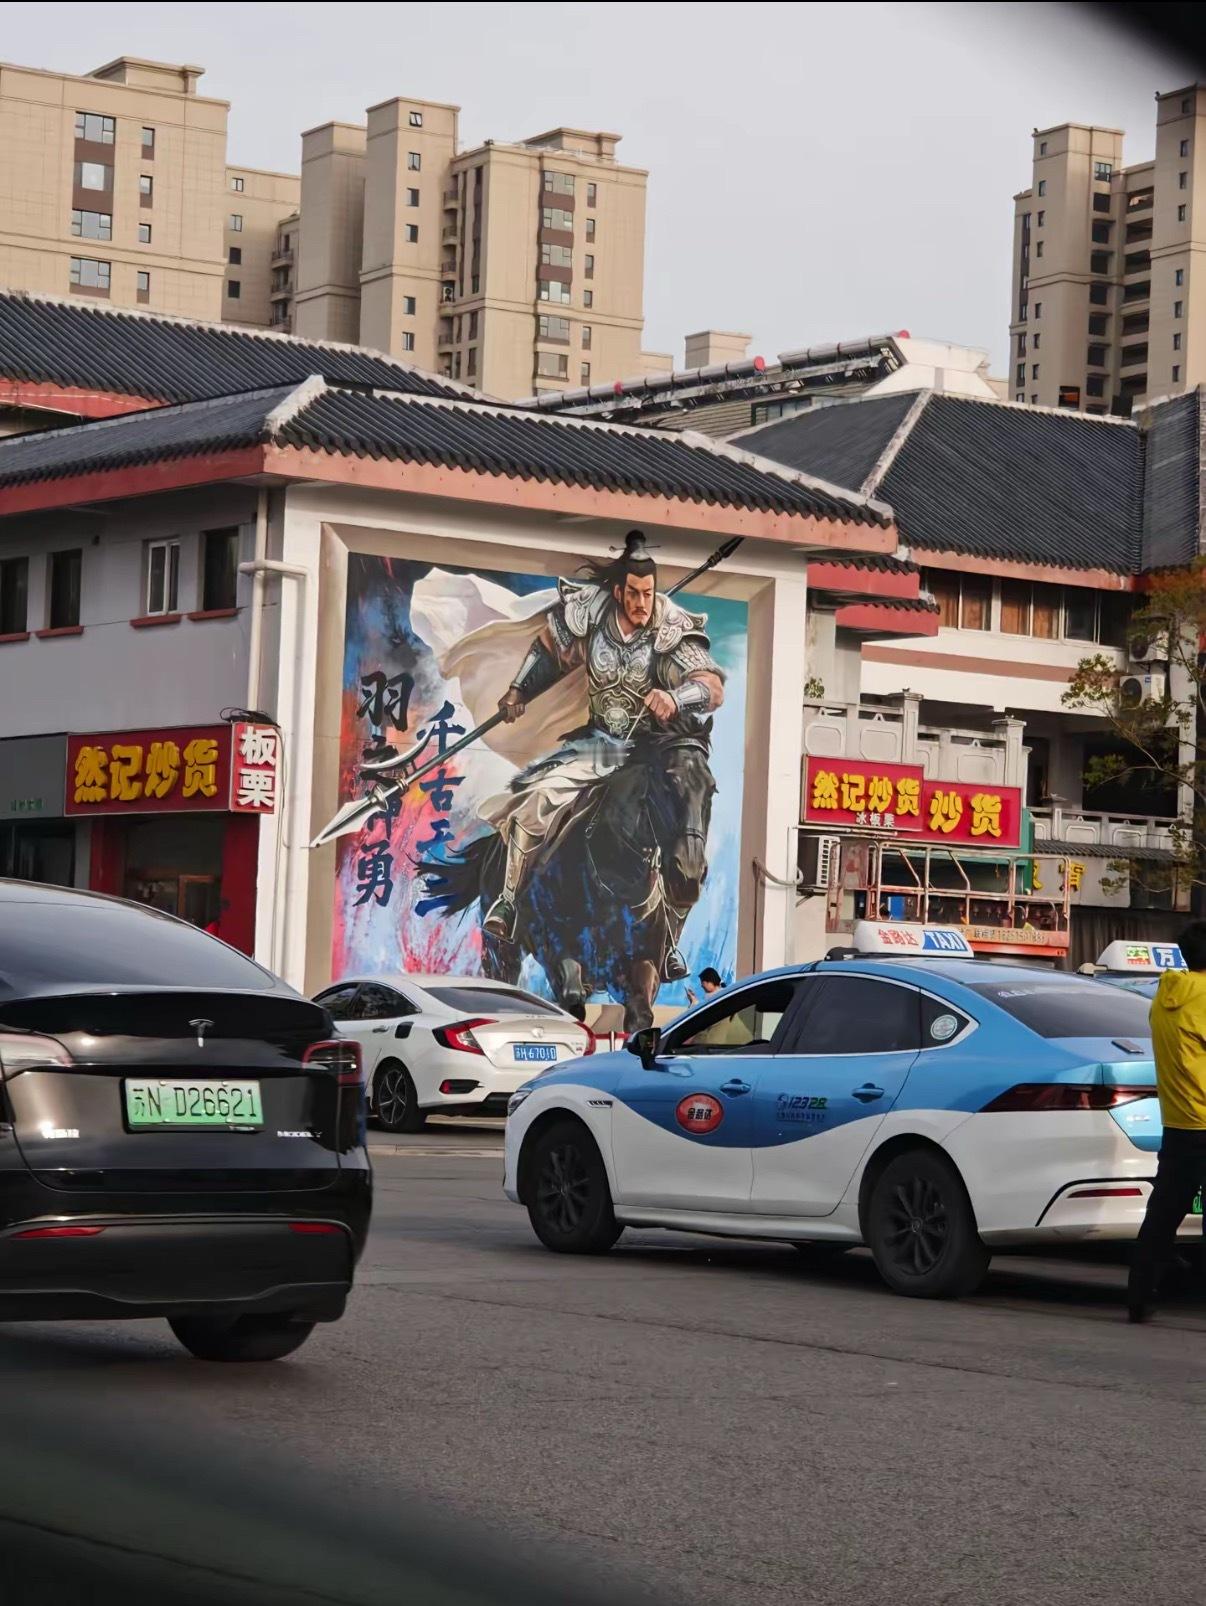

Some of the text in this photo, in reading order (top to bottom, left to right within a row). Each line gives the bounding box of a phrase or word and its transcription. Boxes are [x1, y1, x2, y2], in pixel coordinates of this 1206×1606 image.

[74, 739, 218, 803] 然记炒货
[238, 726, 276, 807] 板栗
[813, 770, 920, 816] 然记炒货
[929, 790, 1003, 837] 炒货
[925, 931, 966, 950] TAXI
[788, 1096, 828, 1110] 12328
